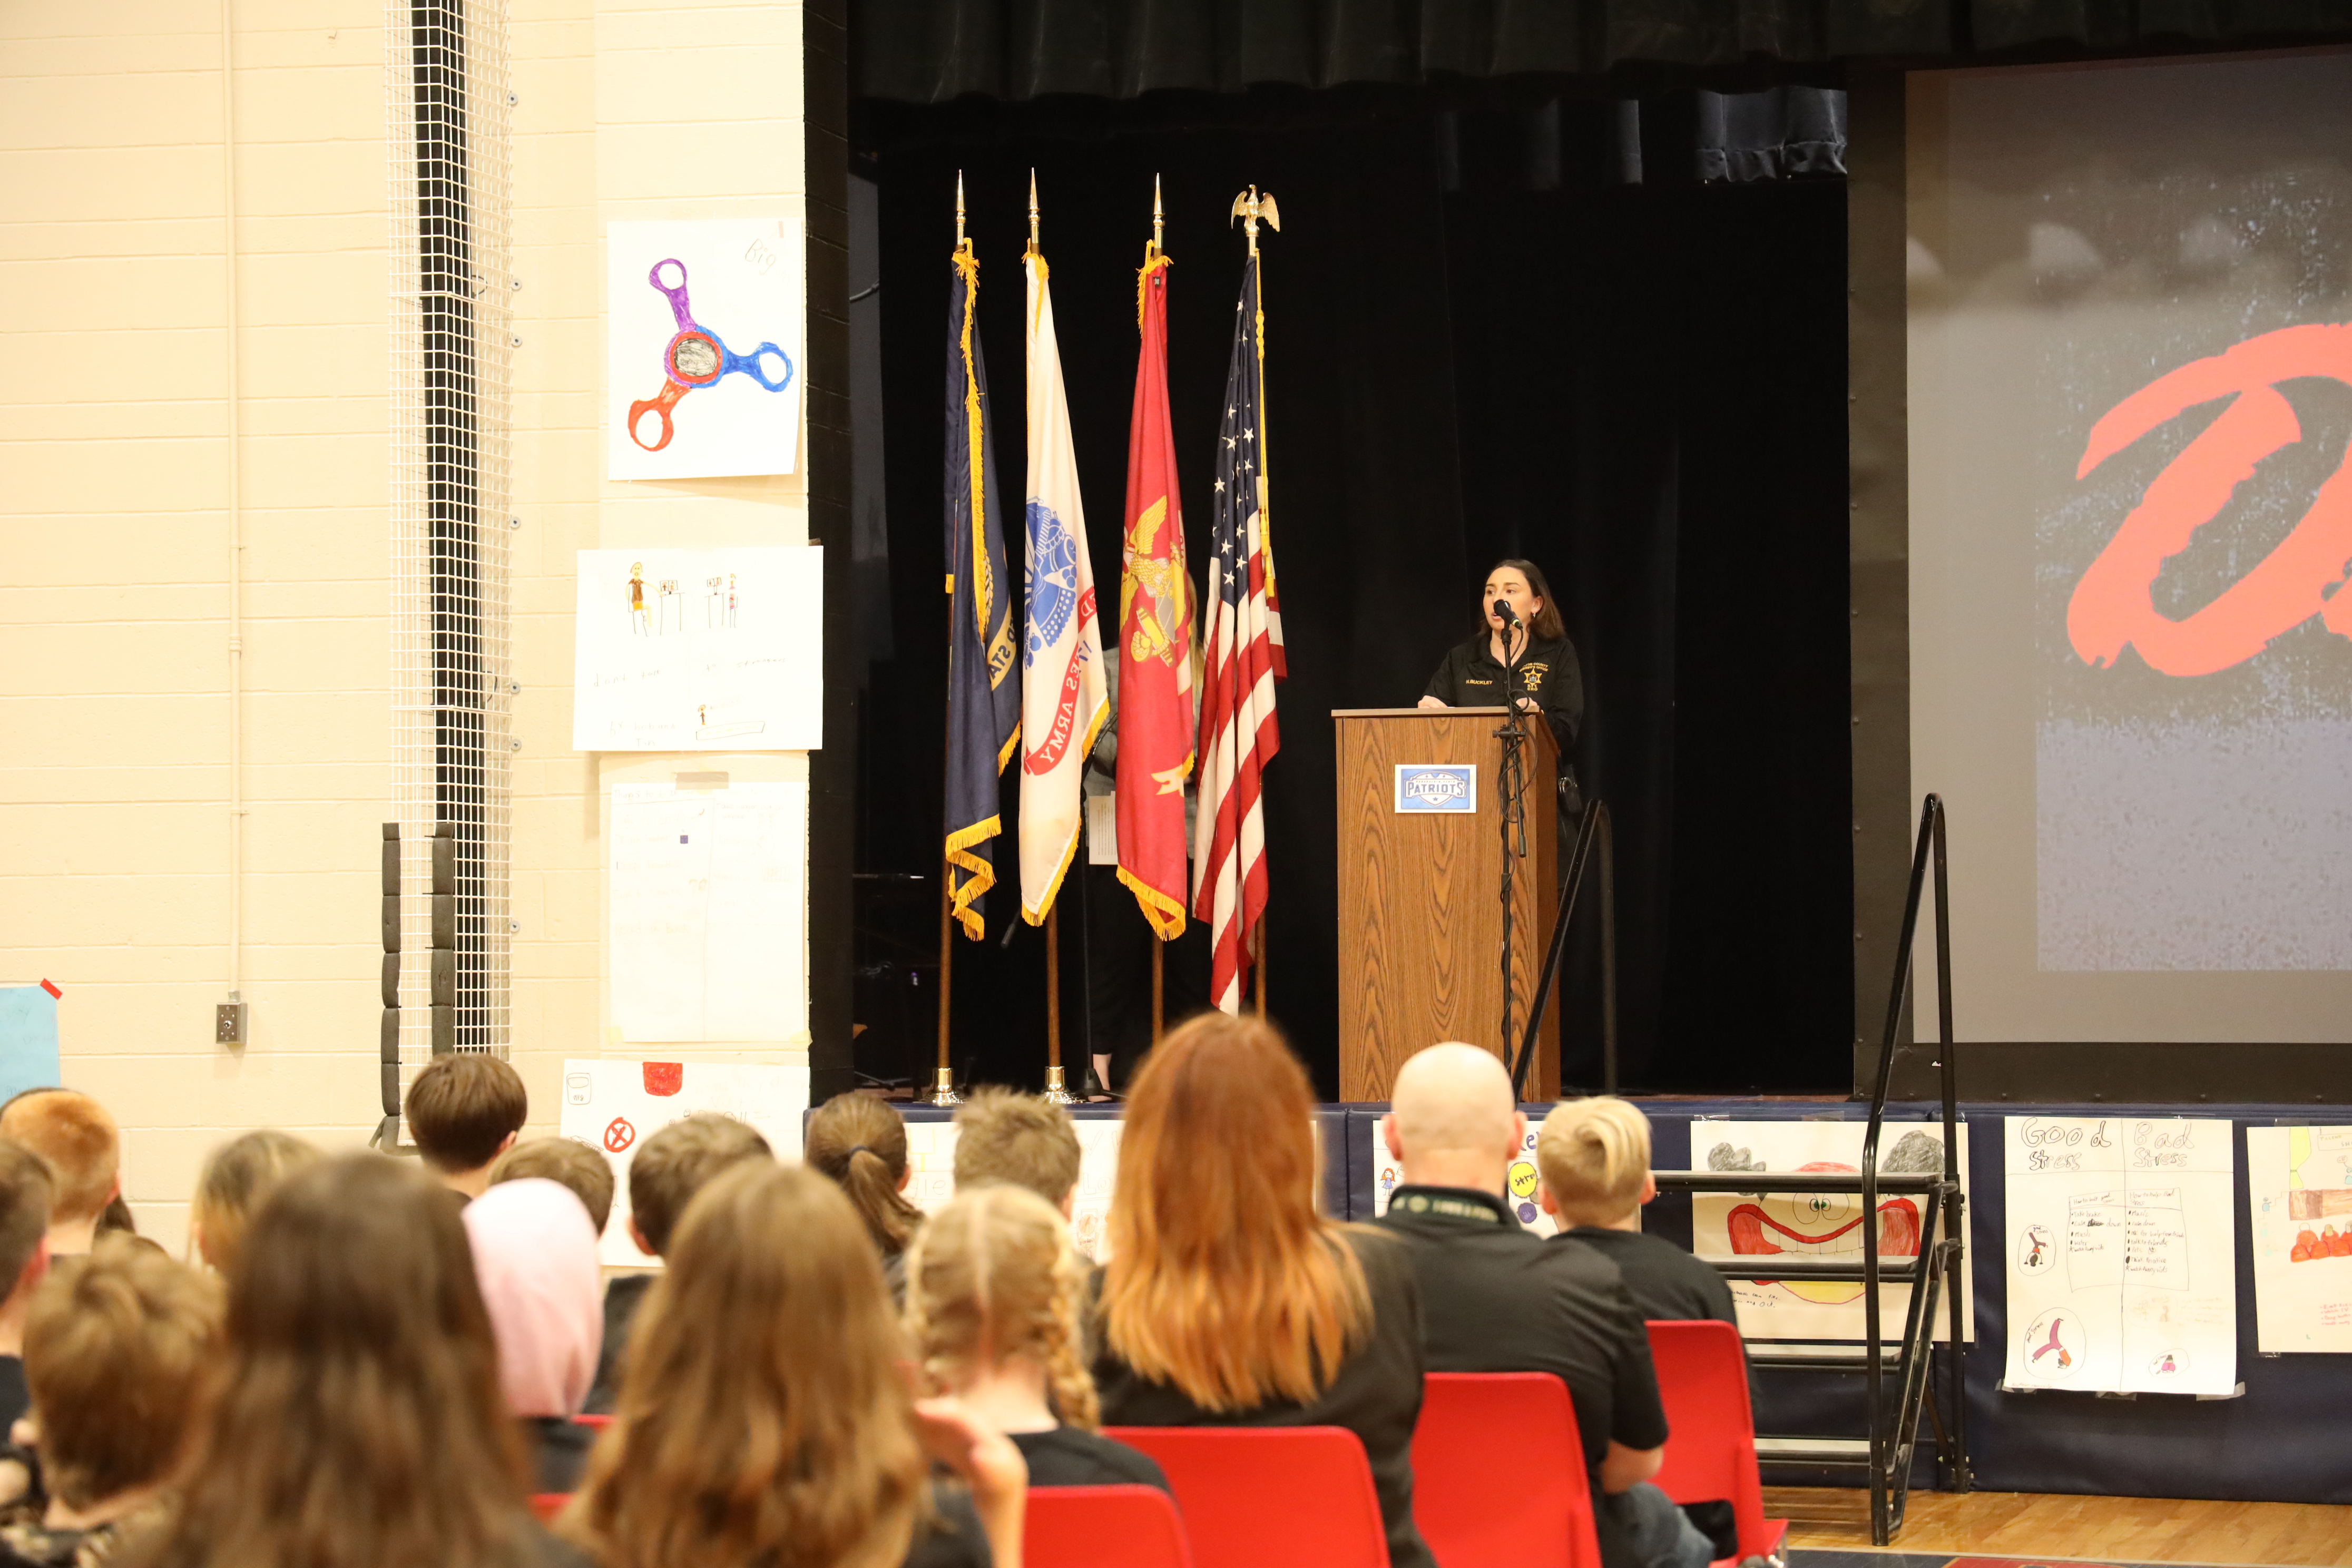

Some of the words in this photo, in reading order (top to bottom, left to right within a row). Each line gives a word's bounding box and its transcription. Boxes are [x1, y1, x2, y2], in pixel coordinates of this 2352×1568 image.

[744, 238, 777, 276] Big
[1407, 782, 1464, 796] PATRIOTS
[2134, 1121, 2194, 1149] Bad
[2106, 1217, 2121, 1227] down
